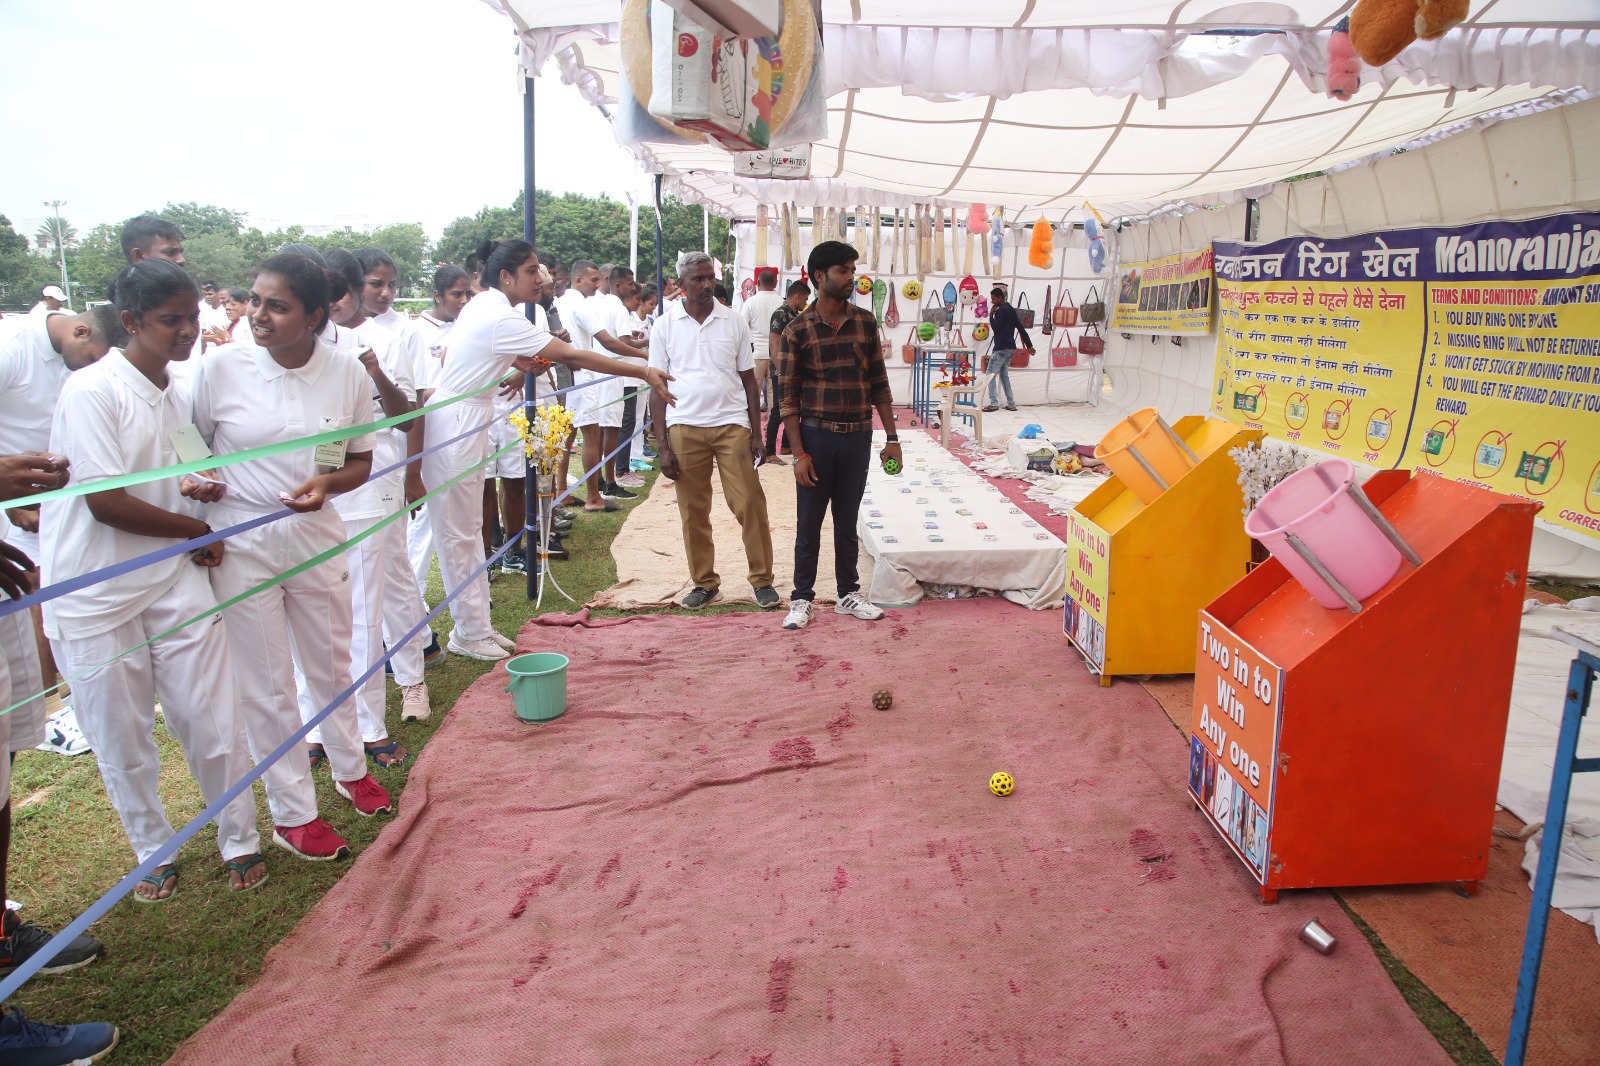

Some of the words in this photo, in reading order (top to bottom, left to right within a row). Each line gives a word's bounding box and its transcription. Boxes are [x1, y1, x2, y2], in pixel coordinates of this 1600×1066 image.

[789, 157, 806, 166] BITES
[1298, 241, 1350, 278] रिंग
[1361, 237, 1420, 278] खेल
[1435, 224, 1600, 273] Manoranja
[1264, 286, 1298, 305] करने
[1303, 287, 1314, 306] से
[1319, 287, 1348, 311] पहले
[1353, 287, 1374, 309] पैसे
[1379, 287, 1405, 310] देना
[1431, 288, 1458, 304] TERMS
[1461, 289, 1480, 304] AND
[1482, 288, 1538, 305] CONDITIONS
[1585, 284, 1600, 303] SH
[1244, 313, 1260, 322] कर
[1265, 315, 1279, 325] एक
[1283, 315, 1297, 326] एक
[1301, 316, 1315, 325] कर
[1319, 313, 1328, 325] के
[1433, 311, 1440, 324] 1.
[1446, 312, 1463, 326] YOU
[1466, 311, 1484, 326] BUY
[1485, 312, 1506, 328] RING
[1508, 313, 1526, 328] ONE
[1270, 334, 1293, 344] वापस
[1297, 333, 1313, 347] नही
[1434, 332, 1441, 346] 2.
[1447, 333, 1481, 349] MISSING
[1483, 335, 1505, 351] RING
[1507, 336, 1525, 352] WILL
[1526, 337, 1545, 353] NOT
[1546, 338, 1558, 354] BE
[1254, 352, 1268, 362] कर
[1301, 353, 1311, 367] तो
[1315, 355, 1338, 371] ईनाम
[1342, 361, 1359, 375] नही
[1430, 353, 1437, 367] 3.
[1444, 354, 1471, 371] WON'T
[1472, 357, 1489, 372] GET
[1488, 359, 1518, 376] STUCK
[1515, 361, 1529, 377] BY
[1527, 362, 1564, 381] MOVING
[1564, 364, 1591, 383] FROM
[1234, 369, 1252, 381] पूरा
[1281, 375, 1292, 385] पर
[1296, 376, 1306, 388] ही
[1309, 376, 1334, 392] ईनाम
[1426, 374, 1433, 388] 4.
[1442, 376, 1459, 392] YOU
[1460, 378, 1479, 395] WILL
[1480, 382, 1497, 397] GET
[1497, 384, 1513, 400] THE
[1513, 385, 1548, 404] REWARD
[1549, 390, 1573, 408] ONLY
[1572, 392, 1583, 409] IF
[1435, 397, 1468, 416] REWARD.
[1286, 431, 1301, 442] सही
[1070, 515, 1085, 543] Two
[1087, 527, 1095, 551] in
[1097, 535, 1105, 559] to
[1078, 549, 1093, 578] Win
[1070, 570, 1084, 602] Any
[1085, 588, 1101, 613] one
[1201, 621, 1230, 670] Two
[1233, 648, 1249, 688] in
[1254, 665, 1272, 705] to
[1217, 675, 1245, 729] Win
[1199, 704, 1227, 758] Any
[1230, 740, 1261, 787] one
